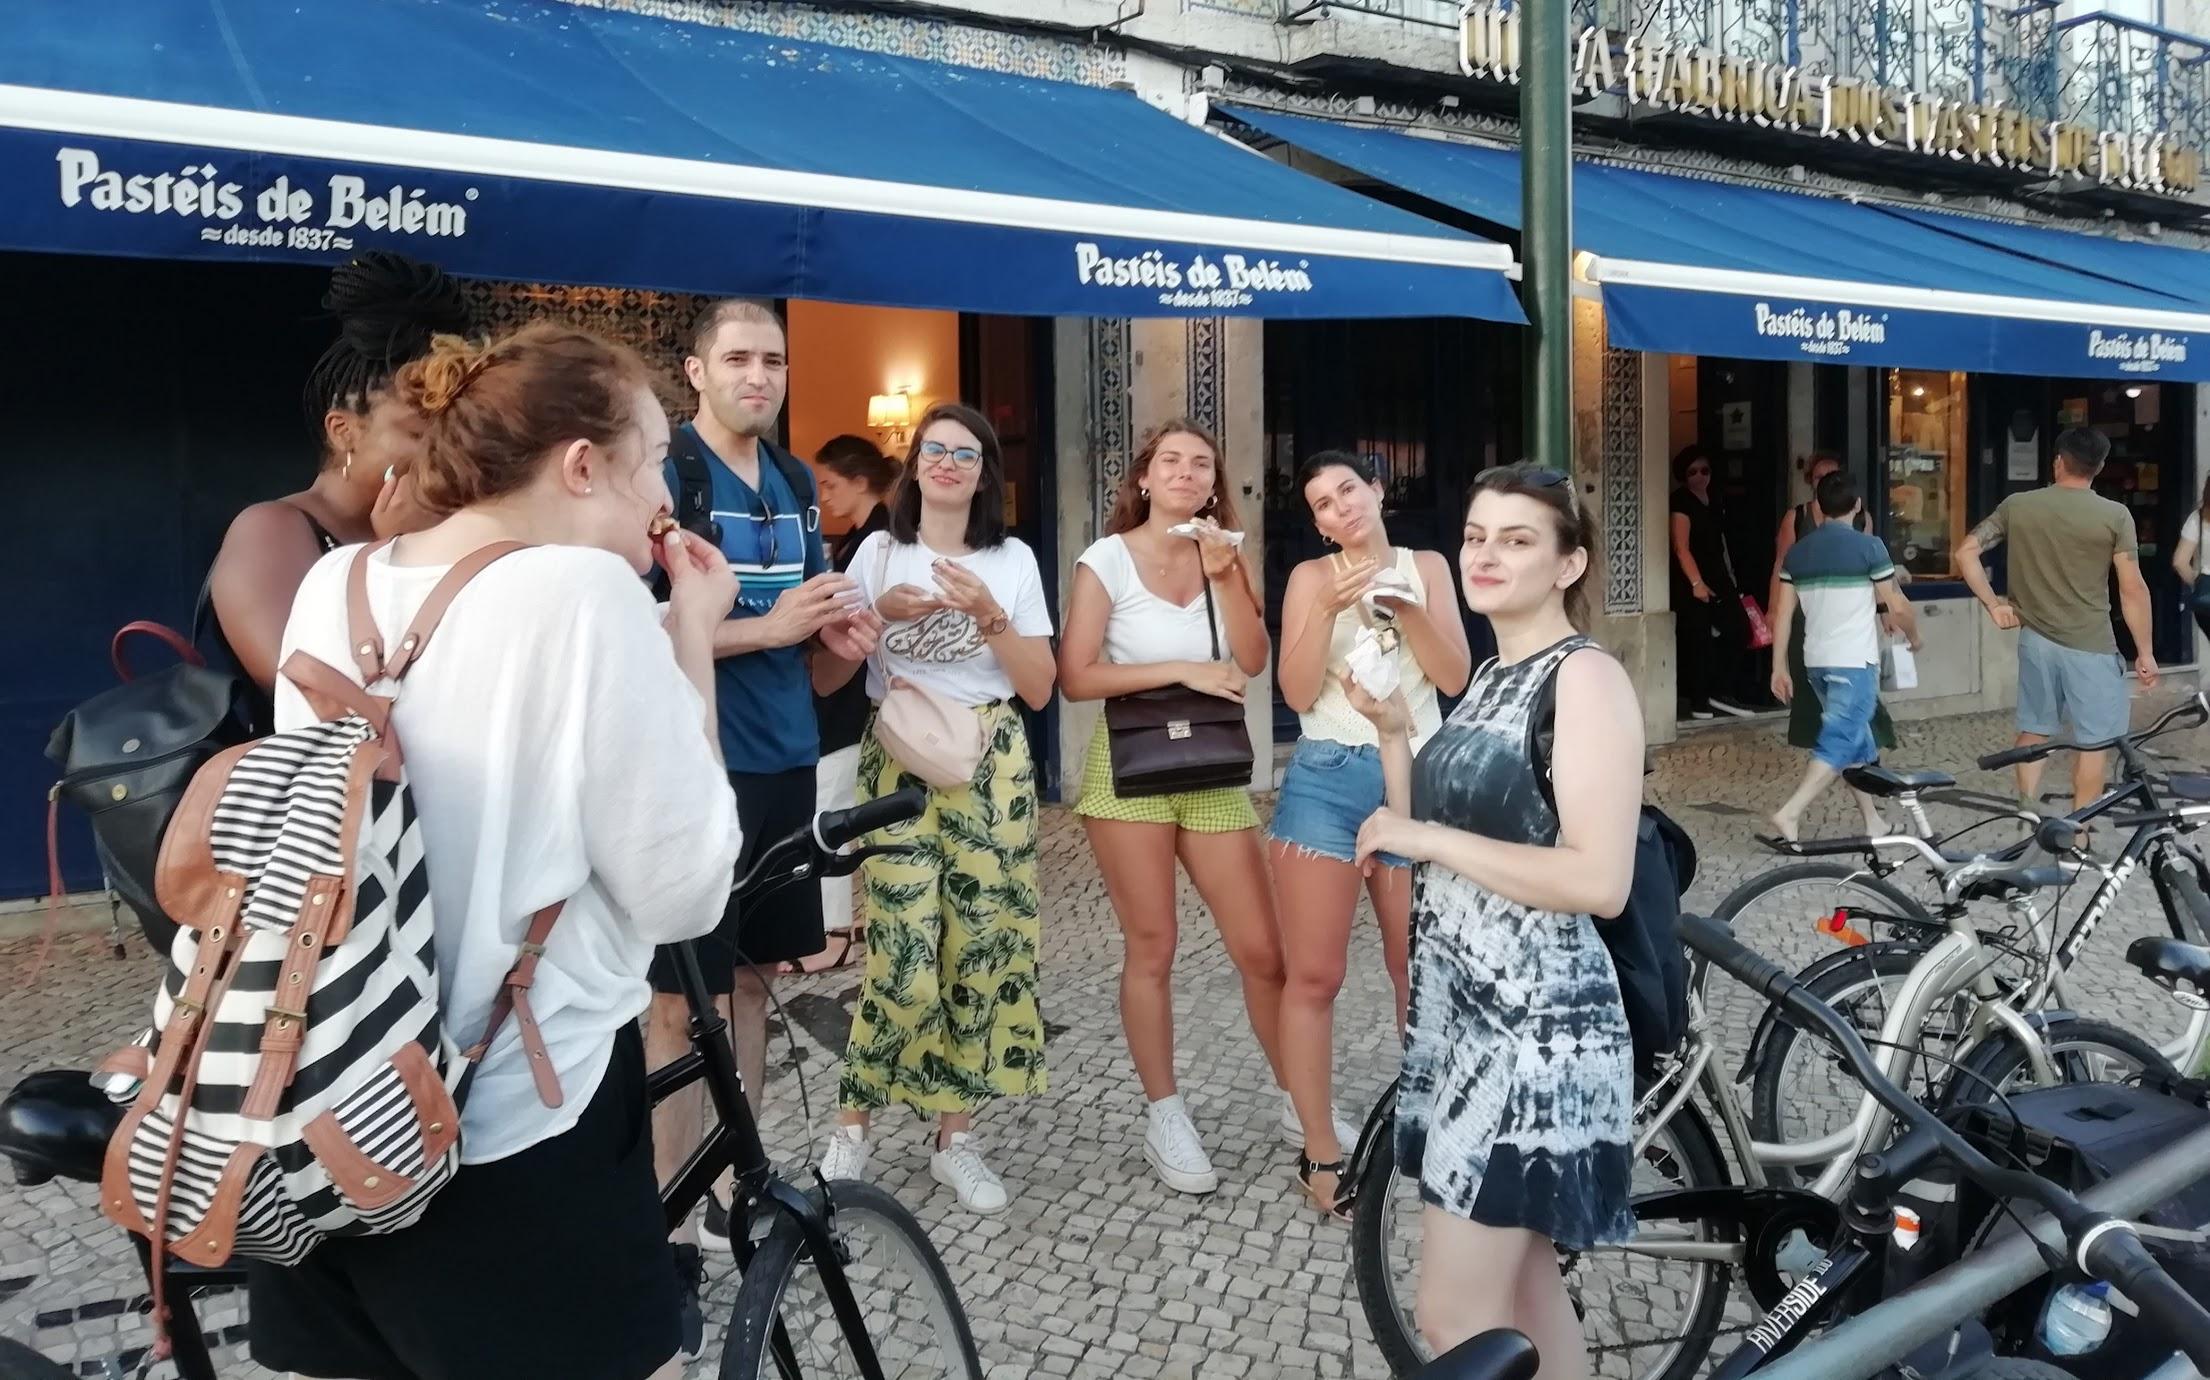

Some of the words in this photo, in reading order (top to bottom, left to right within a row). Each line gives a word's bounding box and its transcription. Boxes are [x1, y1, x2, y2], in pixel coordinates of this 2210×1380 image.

[56, 147, 244, 220] Pastéis
[257, 175, 313, 225] de
[223, 223, 284, 247] desde
[287, 226, 335, 251] 1837
[1075, 242, 1182, 288] Pastéis
[1187, 255, 1222, 288] de
[1173, 289, 1209, 307] desde
[1755, 302, 1813, 338] Pastéis
[1816, 311, 1835, 338] de
[2133, 335, 2149, 359] de
[1746, 1275, 1828, 1354] RIVERSIDE
